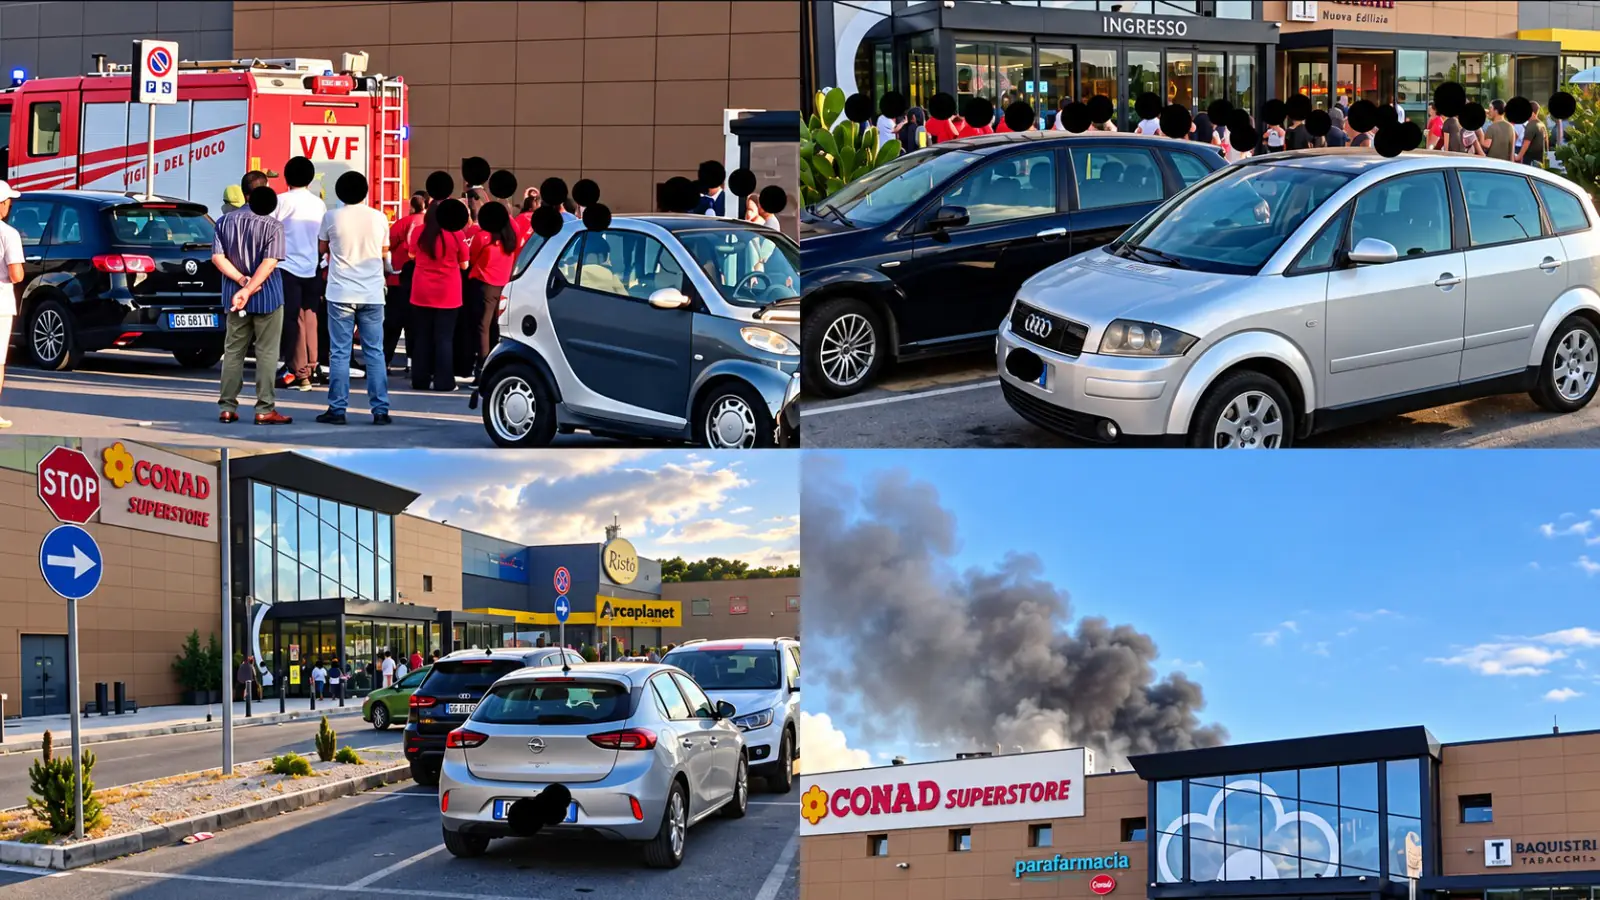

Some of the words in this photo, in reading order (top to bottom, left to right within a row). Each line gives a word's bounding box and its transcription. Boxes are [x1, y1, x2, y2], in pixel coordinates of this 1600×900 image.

[1103, 16, 1188, 37] INGRESSO
[1322, 10, 1352, 22] Nuova
[298, 135, 360, 160] VVF
[123, 162, 159, 186] VIGII
[164, 153, 184, 172] DEL
[189, 139, 226, 163] FUOCO
[43, 467, 97, 503] STOP
[134, 459, 211, 500] CONAD
[127, 496, 210, 528] SUPERSTORE
[600, 600, 675, 621] Arcaplanet
[830, 780, 941, 818] CONAD
[945, 779, 1071, 809] SUPERSTORE
[1491, 842, 1504, 860] T
[1515, 839, 1597, 855] BAQUISTRI
[1015, 851, 1129, 879] parafarmacia
